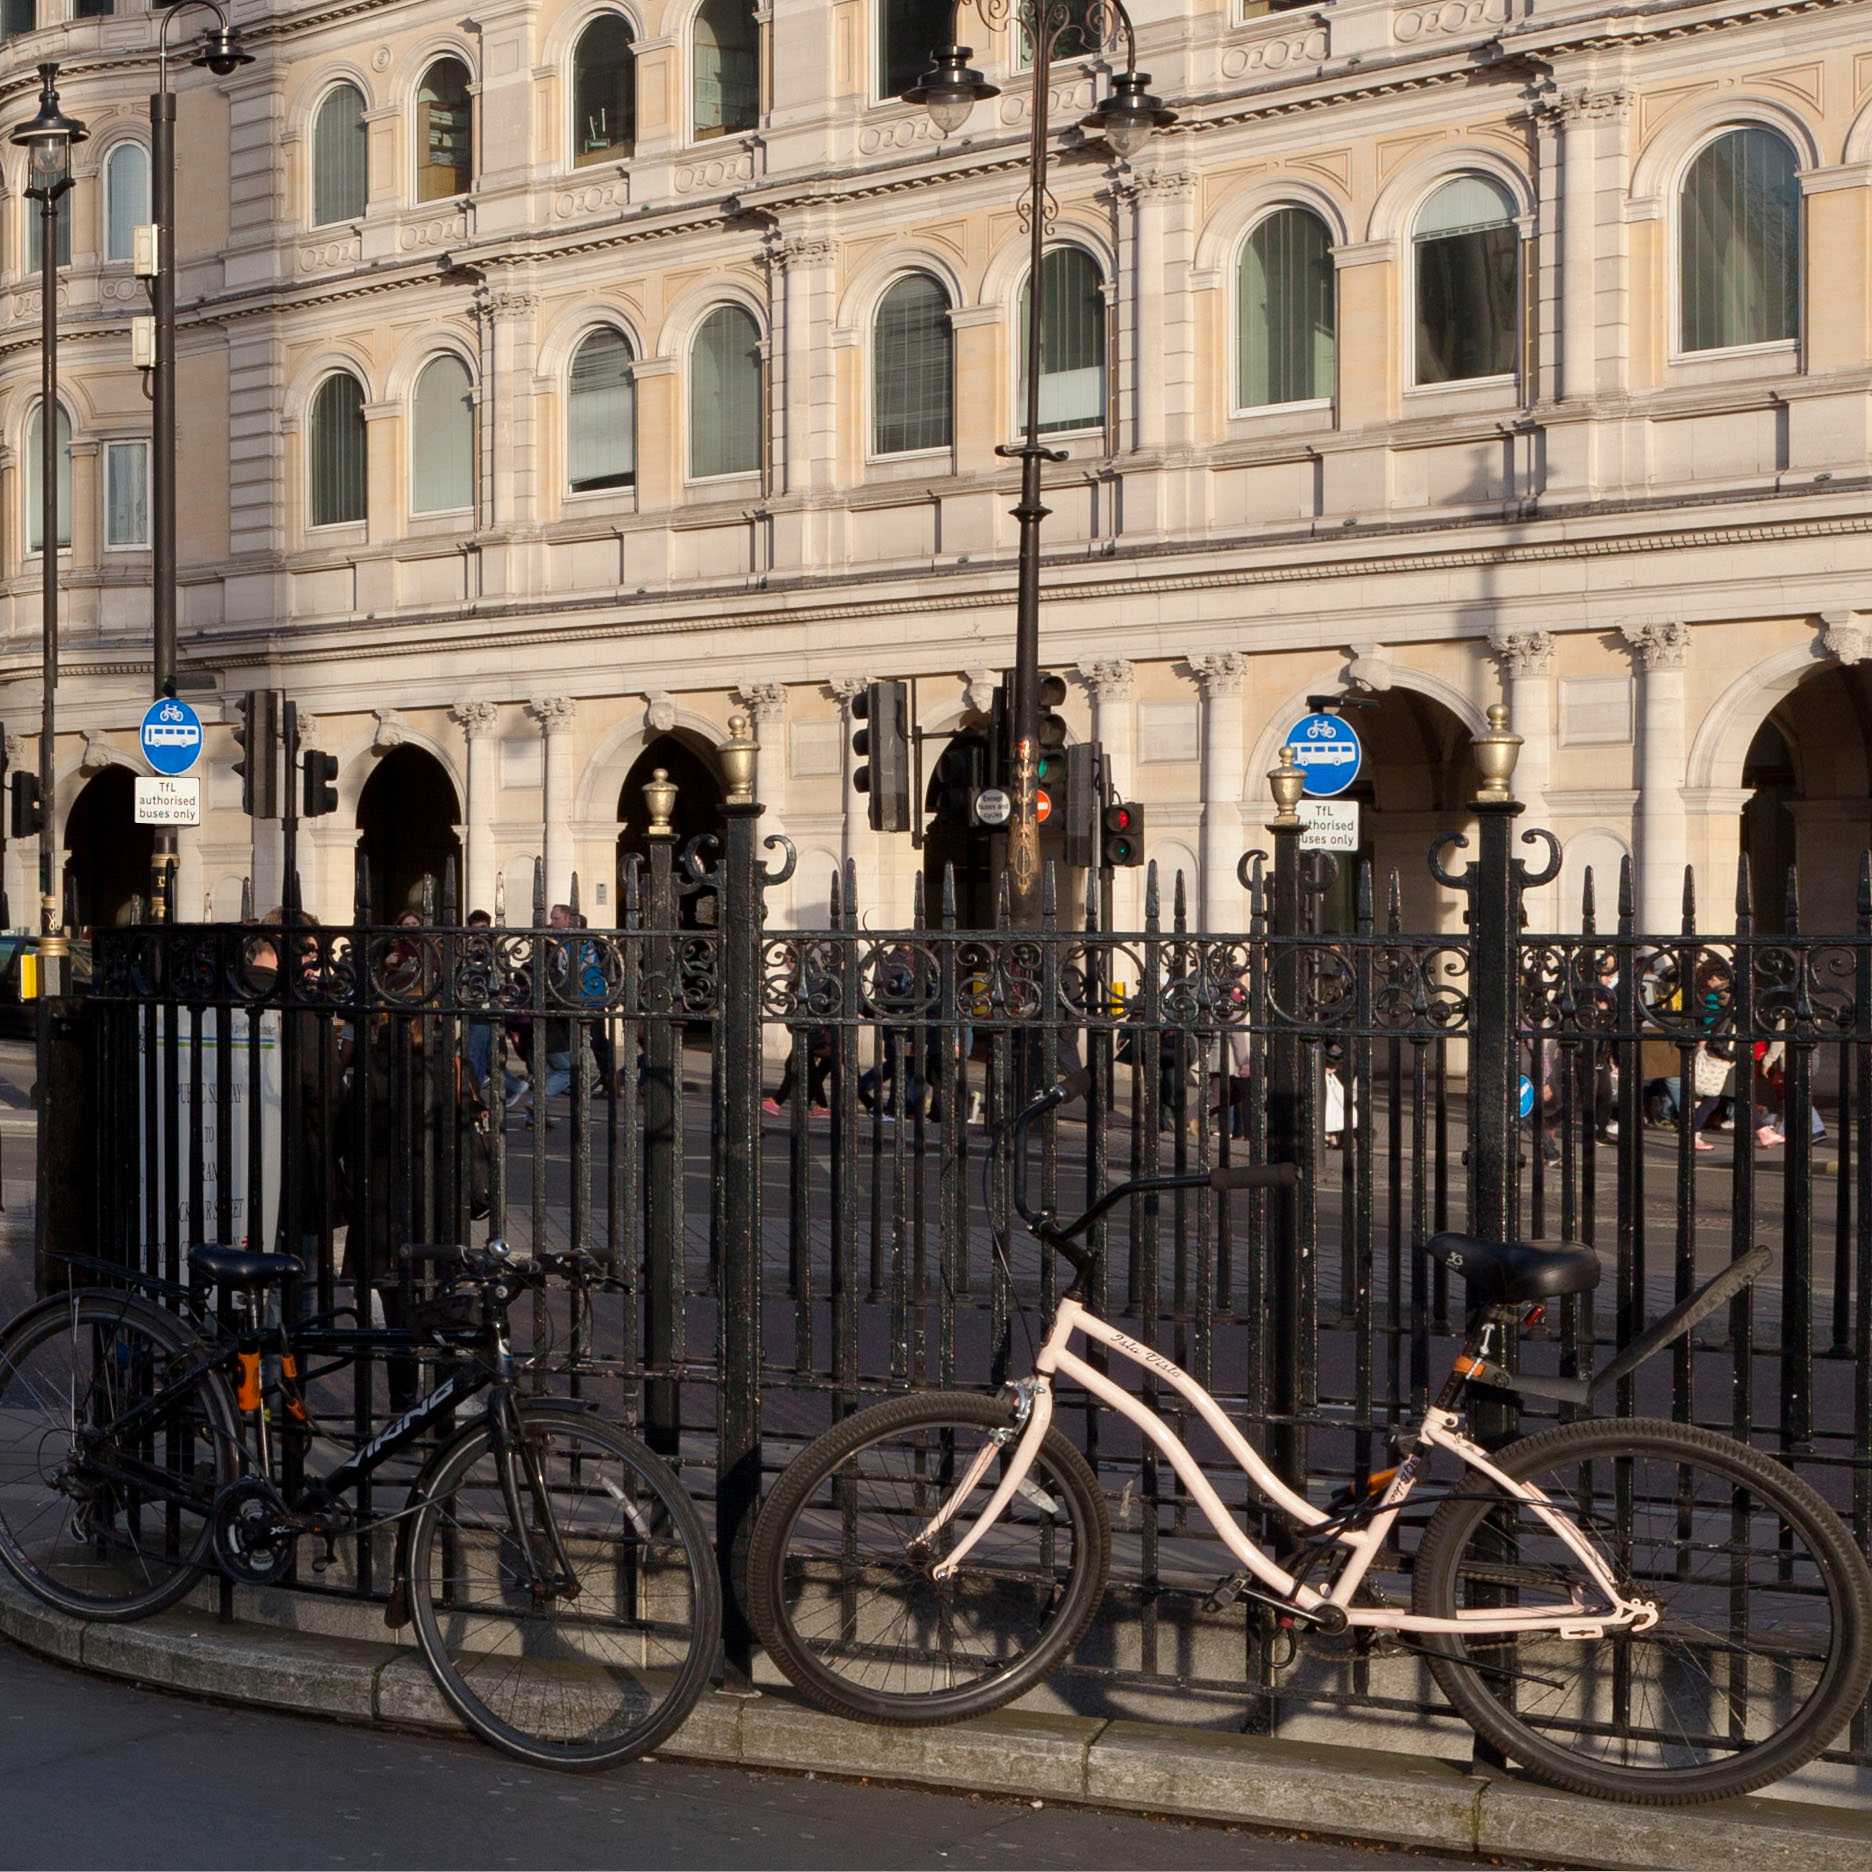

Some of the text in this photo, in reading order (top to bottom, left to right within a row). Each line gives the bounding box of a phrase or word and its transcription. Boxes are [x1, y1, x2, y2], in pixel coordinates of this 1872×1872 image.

[159, 782, 176, 792] TfL
[139, 796, 196, 806] authorised
[139, 808, 196, 820] buses only
[1315, 805, 1334, 816] TfL
[1302, 820, 1354, 831] thorised
[1302, 834, 1354, 847] uses only
[204, 1126, 215, 1143] TO
[1110, 1334, 1181, 1378] Isla Vista
[342, 1377, 455, 1468] VIKING
